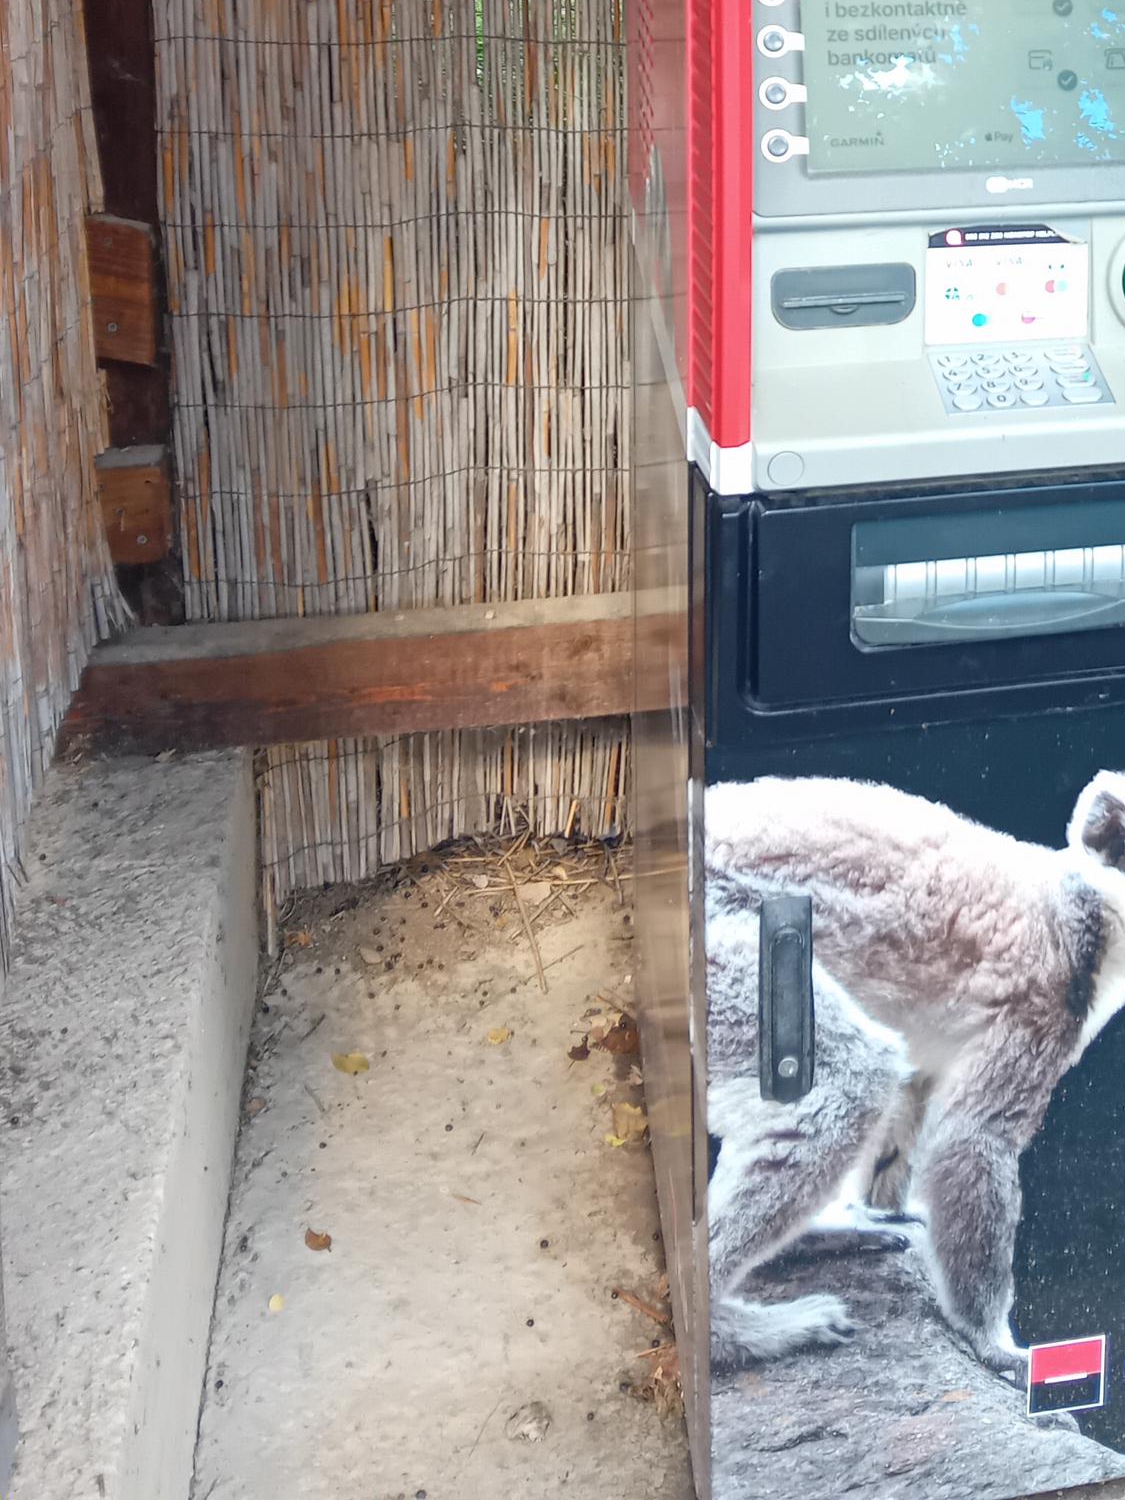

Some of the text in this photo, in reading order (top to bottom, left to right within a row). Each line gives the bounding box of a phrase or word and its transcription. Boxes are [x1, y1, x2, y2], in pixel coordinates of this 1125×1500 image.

[825, 2, 830, 18] i
[827, 28, 849, 42] ze
[830, 135, 884, 148] GARMIN
